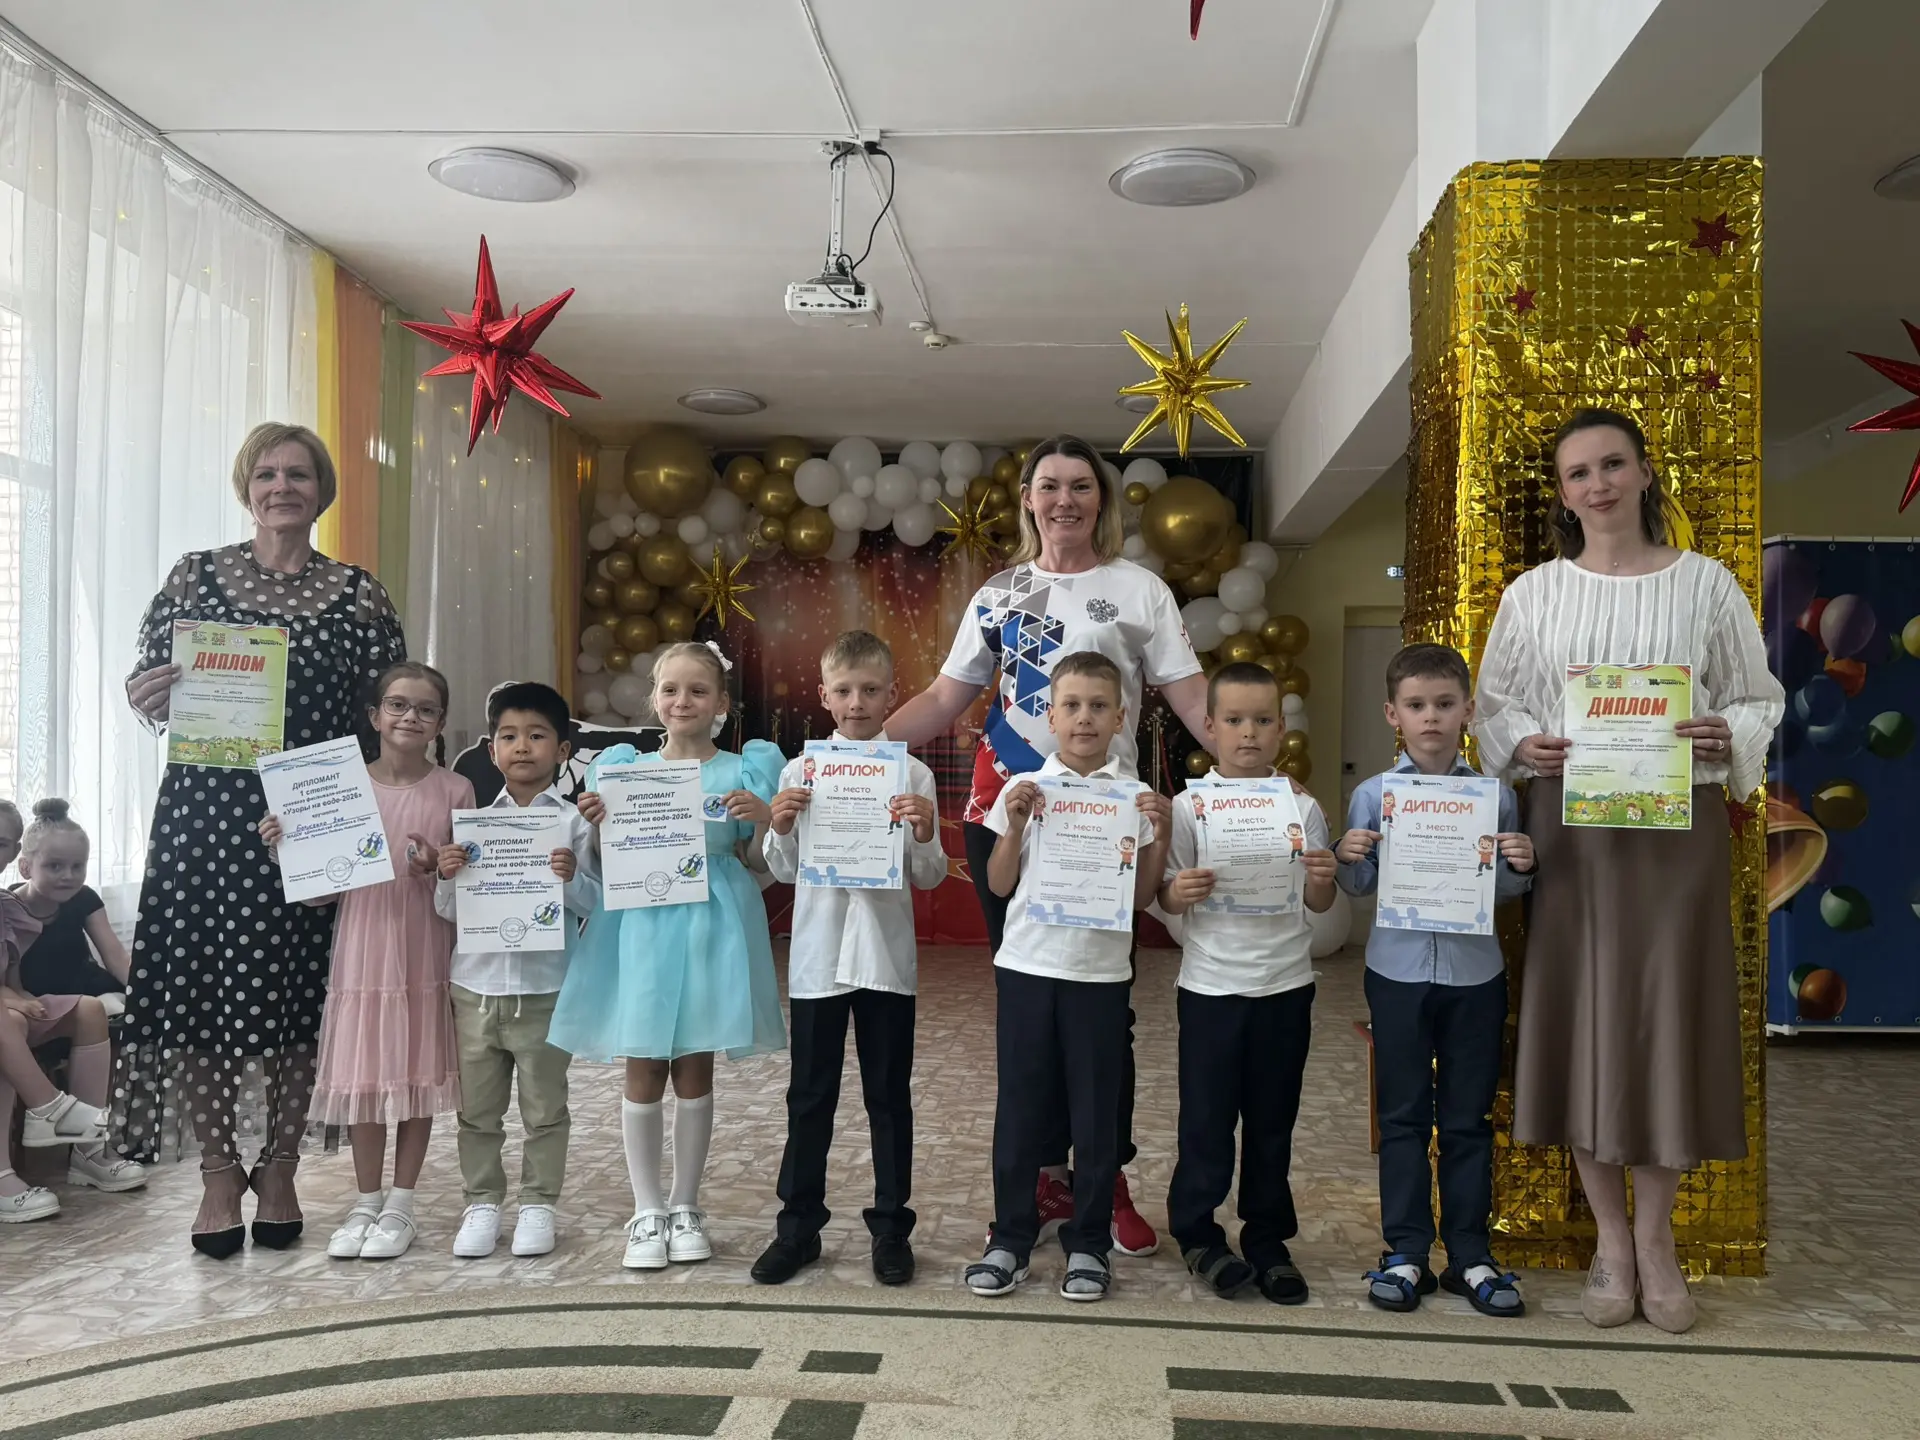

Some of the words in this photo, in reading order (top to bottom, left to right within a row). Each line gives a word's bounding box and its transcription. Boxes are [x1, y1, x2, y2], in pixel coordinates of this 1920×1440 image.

[191, 651, 266, 675] ДИПЛОМ
[1587, 696, 1668, 719] ДИПЛОМ
[821, 764, 884, 778] ДИПЛОМ
[293, 772, 339, 791] ДИПЛОМАНТ
[306, 783, 337, 795] степени
[284, 804, 309, 816] «Узоры
[323, 791, 361, 806] воде-2026»
[626, 791, 675, 802] ДИПЛОМАНТ
[1051, 799, 1117, 817] ДИПЛОМ
[1211, 797, 1275, 811] ДИПЛОМ
[1402, 799, 1473, 816] ДИПЛОМ
[612, 817, 639, 826] «Узоры
[652, 812, 692, 822] воде-2026»
[1073, 824, 1102, 833] место
[1415, 822, 1421, 830] 3
[1426, 823, 1457, 832] место
[483, 838, 533, 846] ДИПЛОМАНТ
